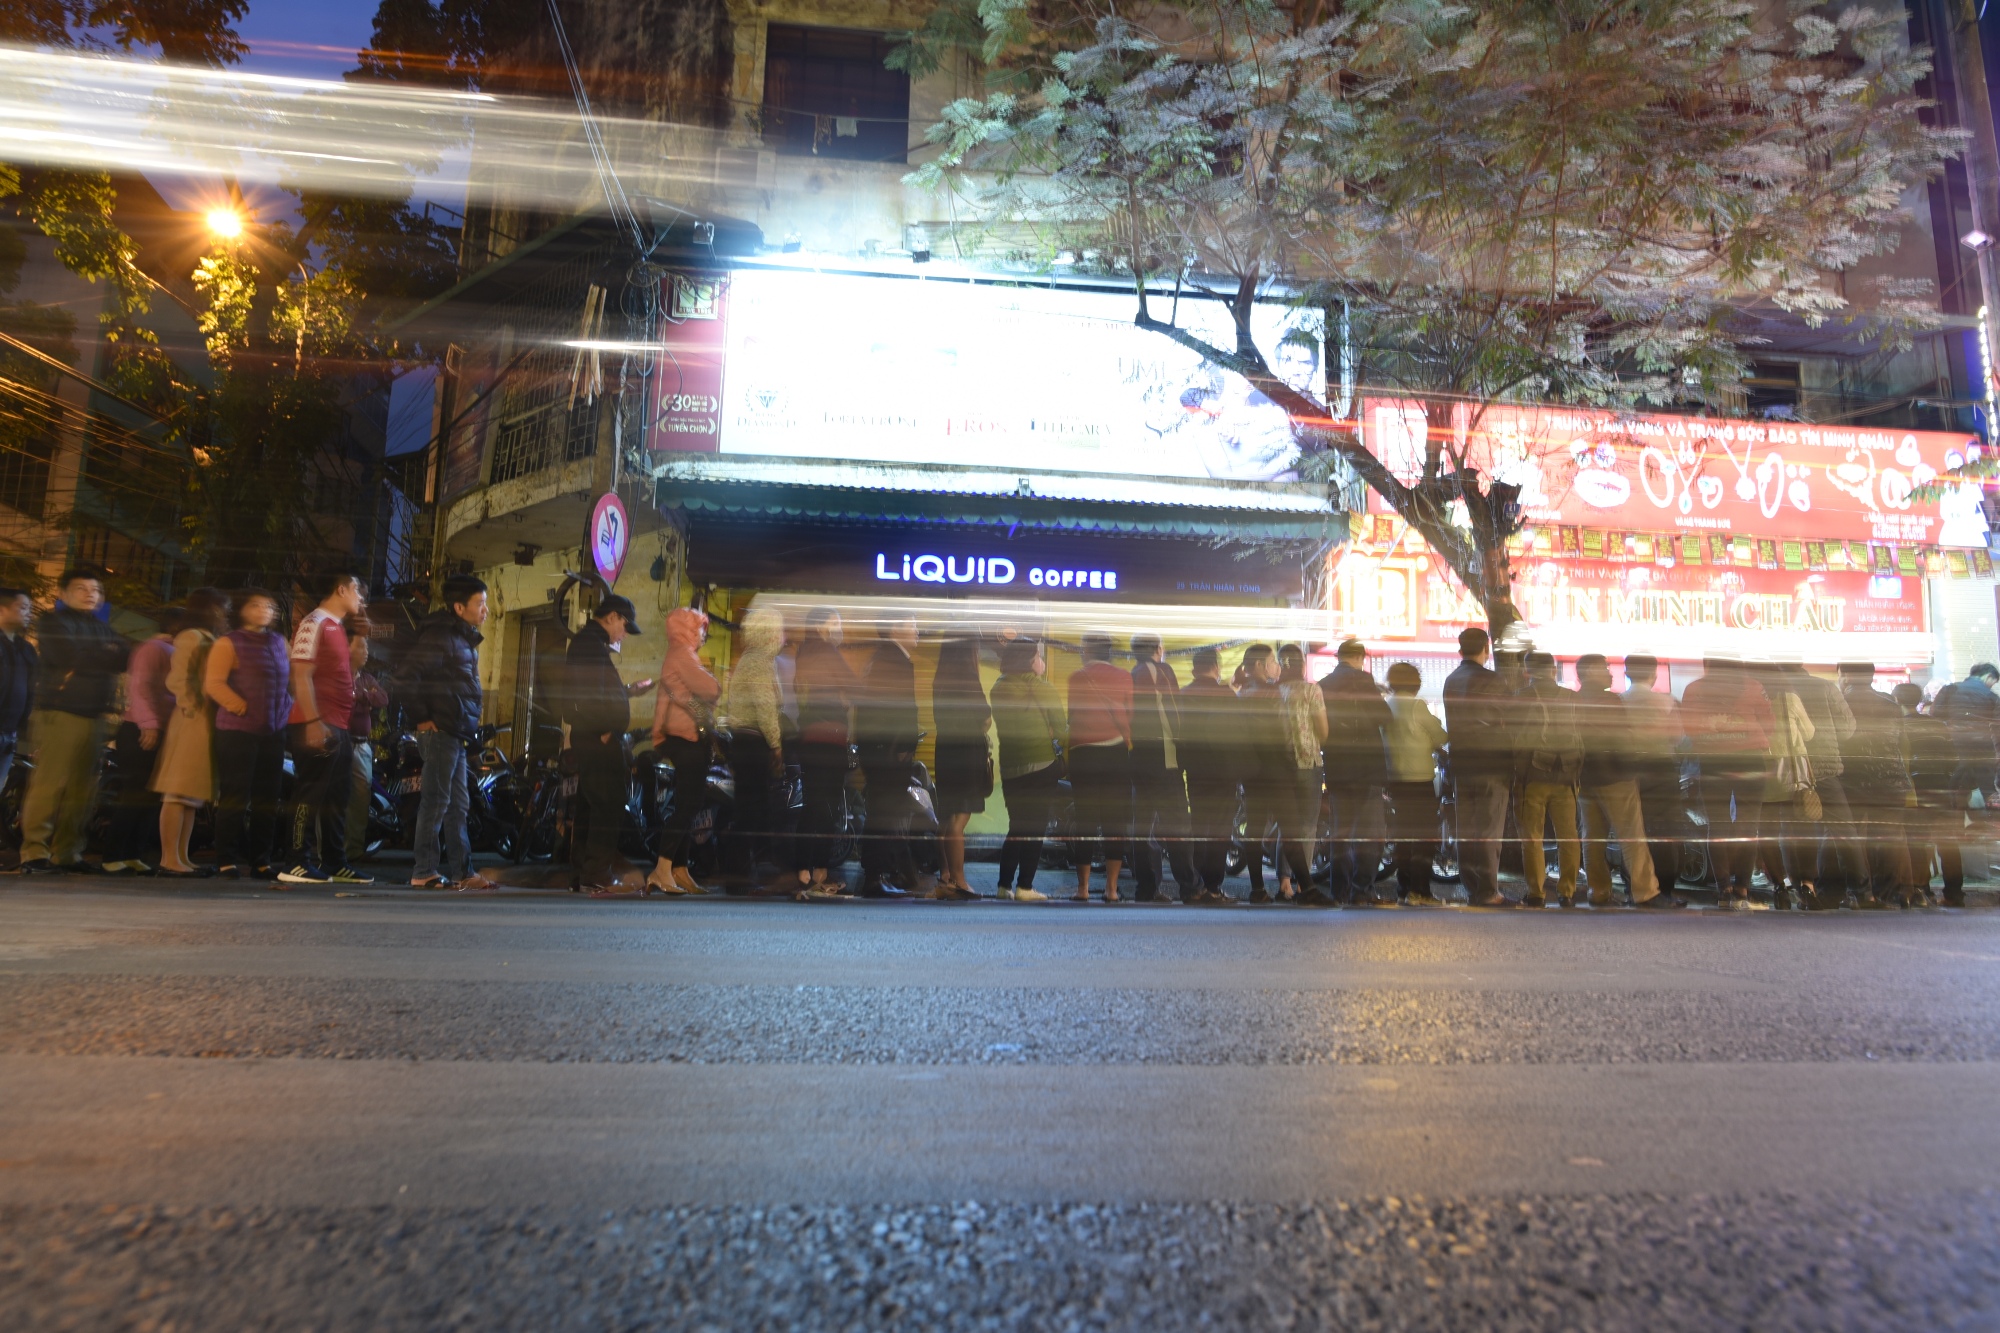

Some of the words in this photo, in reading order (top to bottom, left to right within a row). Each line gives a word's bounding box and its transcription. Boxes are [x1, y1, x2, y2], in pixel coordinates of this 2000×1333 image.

[1823, 431, 1856, 448] MINH
[1029, 568, 1117, 590] COFFEE
[1213, 583, 1235, 593] NHÂN
[1607, 587, 1727, 627] MINH
[1732, 580, 1846, 633] CHÂU
